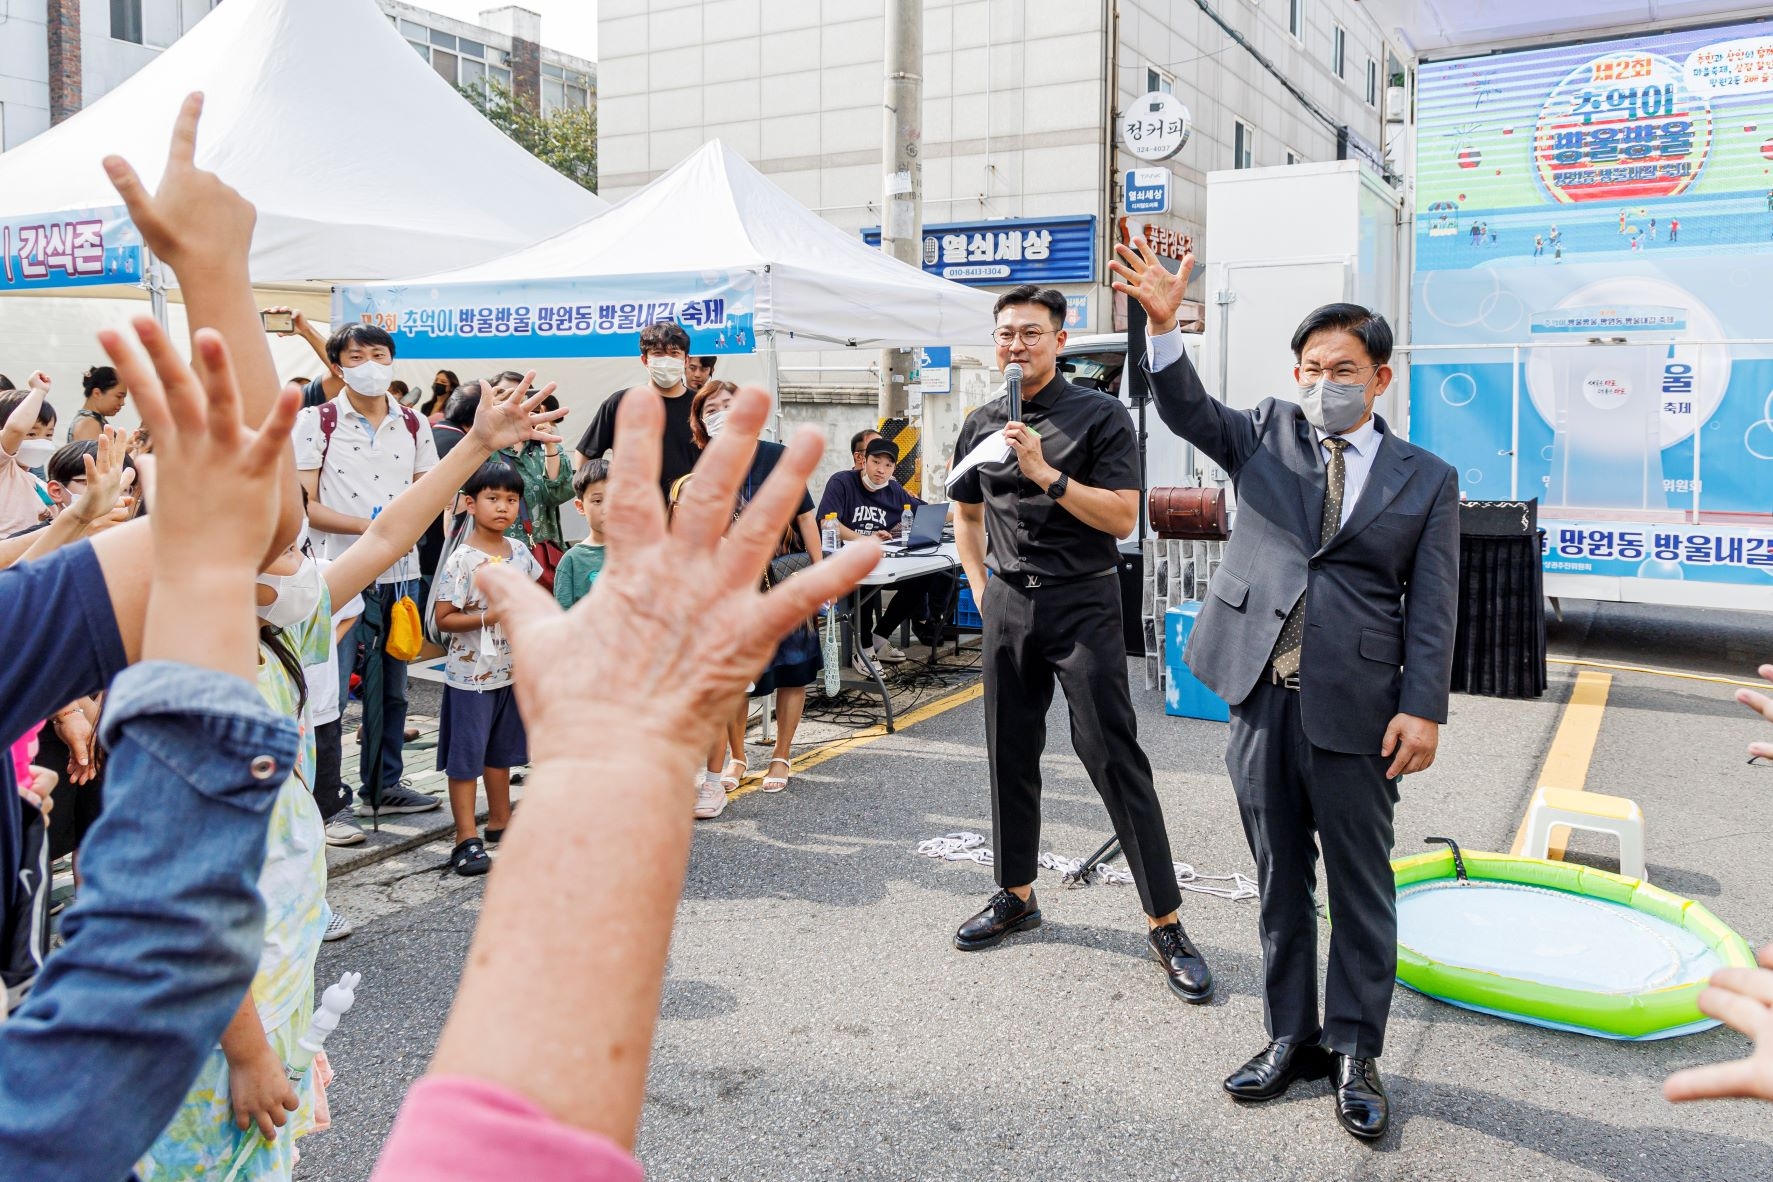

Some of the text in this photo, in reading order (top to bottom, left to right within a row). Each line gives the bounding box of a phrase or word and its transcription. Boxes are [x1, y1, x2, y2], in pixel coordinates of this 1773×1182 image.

[1593, 58, 1651, 82] 제2회
[1571, 84, 1674, 123] 추억이
[1126, 118, 1184, 141] 정커피
[1553, 121, 1695, 164] 방울방울
[1128, 189, 1163, 201] 열쇠세상
[18, 219, 104, 279] 간식존
[942, 230, 1052, 263] 열쇠세상
[403, 309, 453, 335] 추억이
[459, 306, 531, 334] 방울방울
[538, 305, 593, 332] 망원동
[598, 302, 676, 331] 방울내길
[681, 299, 724, 326] 축제
[1664, 402, 1691, 414] 축제
[852, 505, 887, 527] HDEX
[1560, 529, 1644, 559] 망원동
